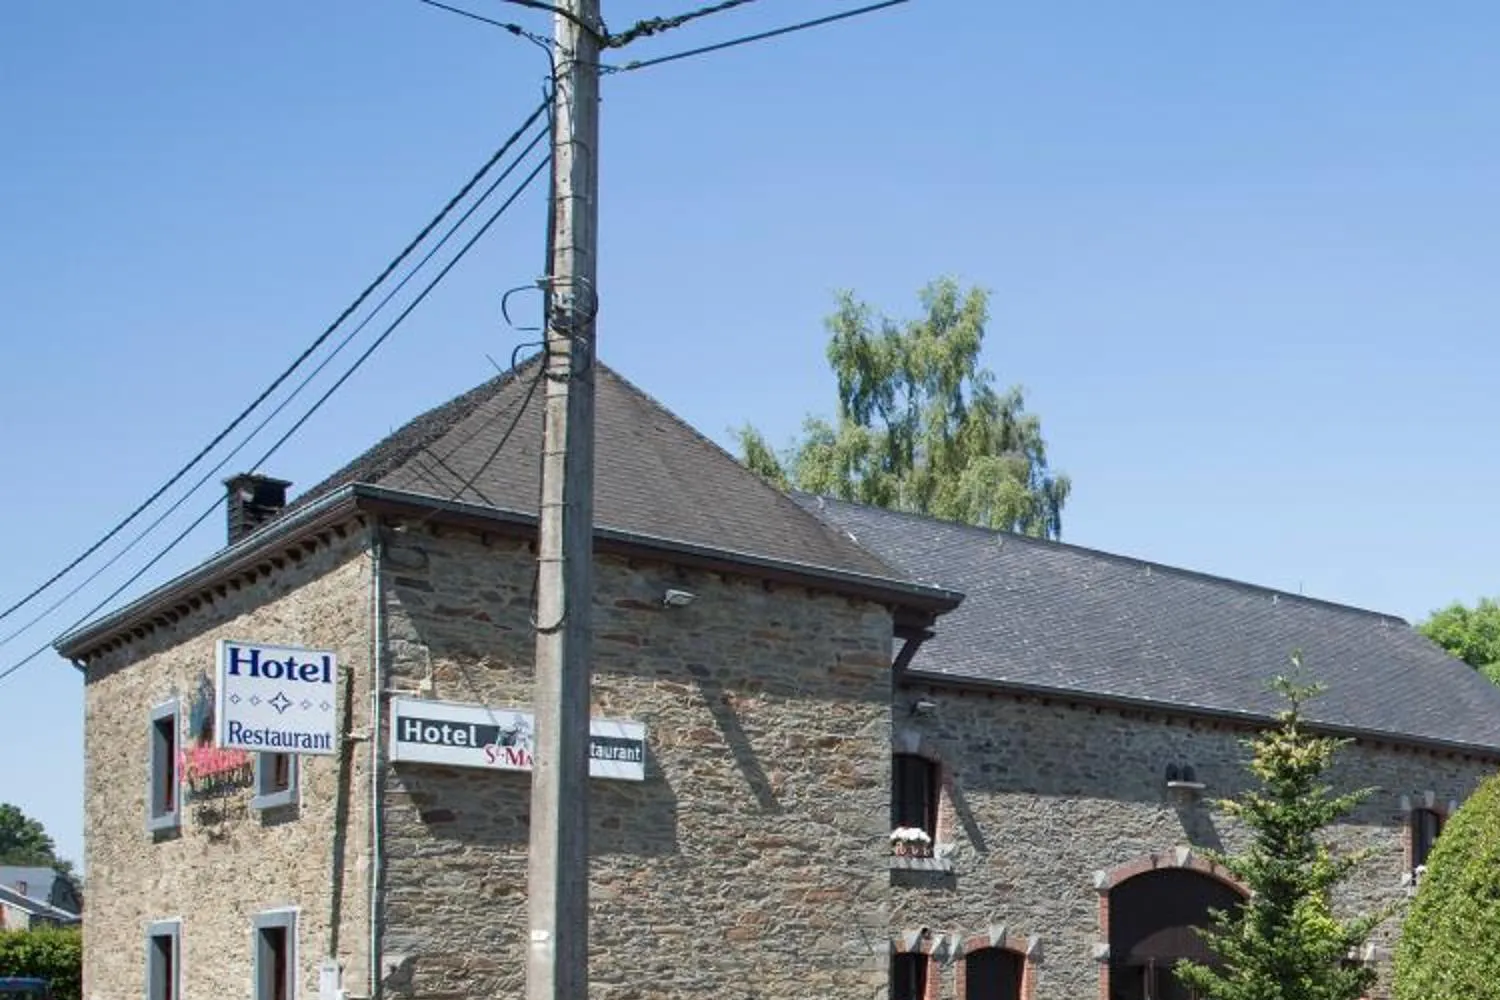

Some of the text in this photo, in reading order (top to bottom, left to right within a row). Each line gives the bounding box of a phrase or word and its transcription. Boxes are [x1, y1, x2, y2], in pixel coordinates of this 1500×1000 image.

[228, 647, 332, 684] Hotel
[228, 720, 332, 749] Restaurant
[404, 719, 641, 761] Hotel taurant
